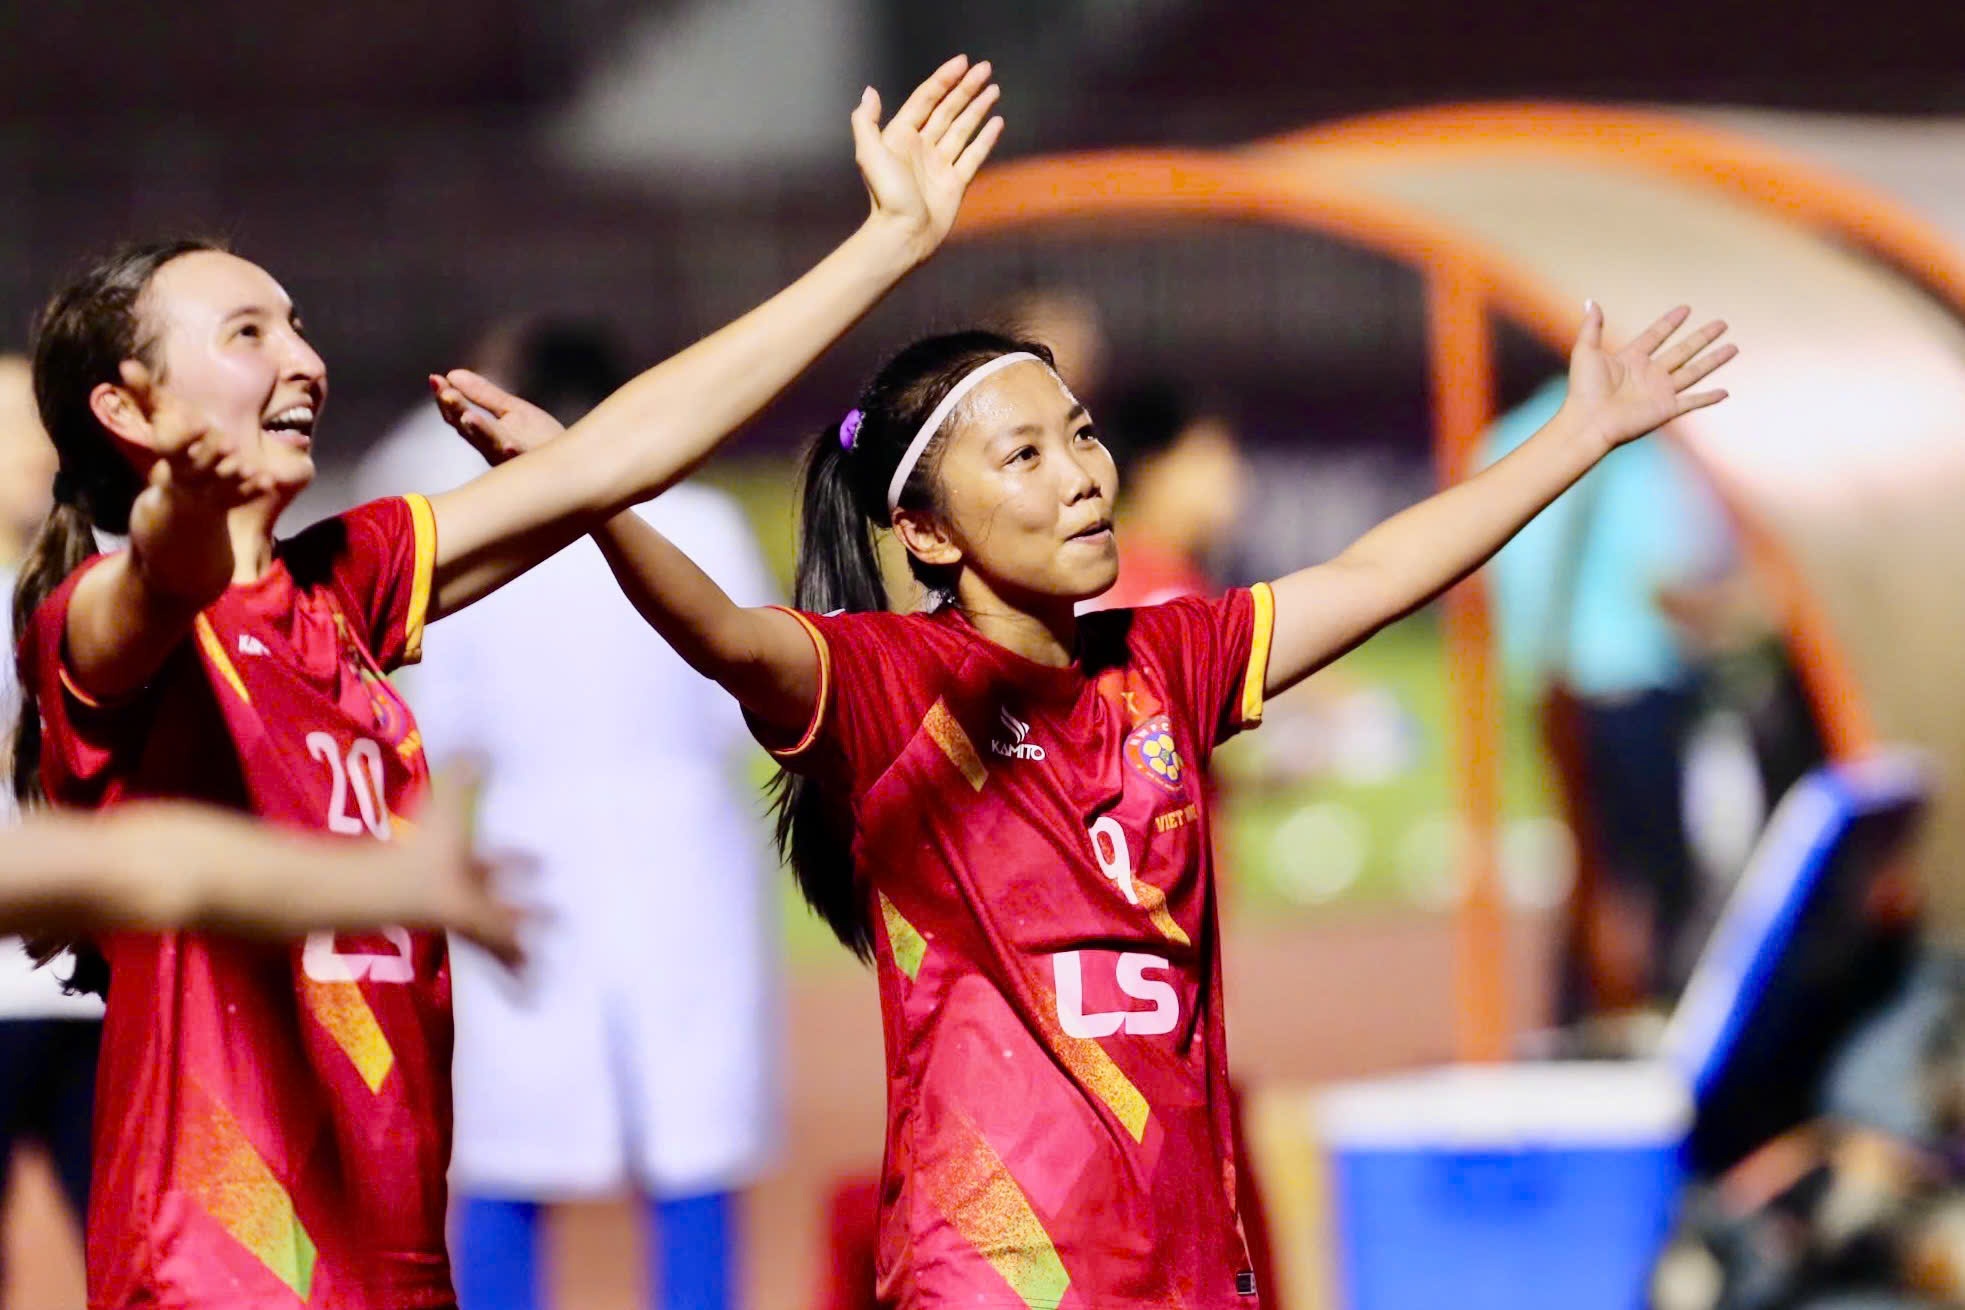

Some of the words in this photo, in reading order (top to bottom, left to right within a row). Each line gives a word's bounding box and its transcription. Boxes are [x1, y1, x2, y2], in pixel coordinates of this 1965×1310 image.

[305, 731, 391, 840] 20
[991, 739, 1046, 761] KAMITO
[1088, 816, 1138, 905] 9
[1155, 809, 1184, 832] VIET
[1053, 950, 1180, 1039] LS
